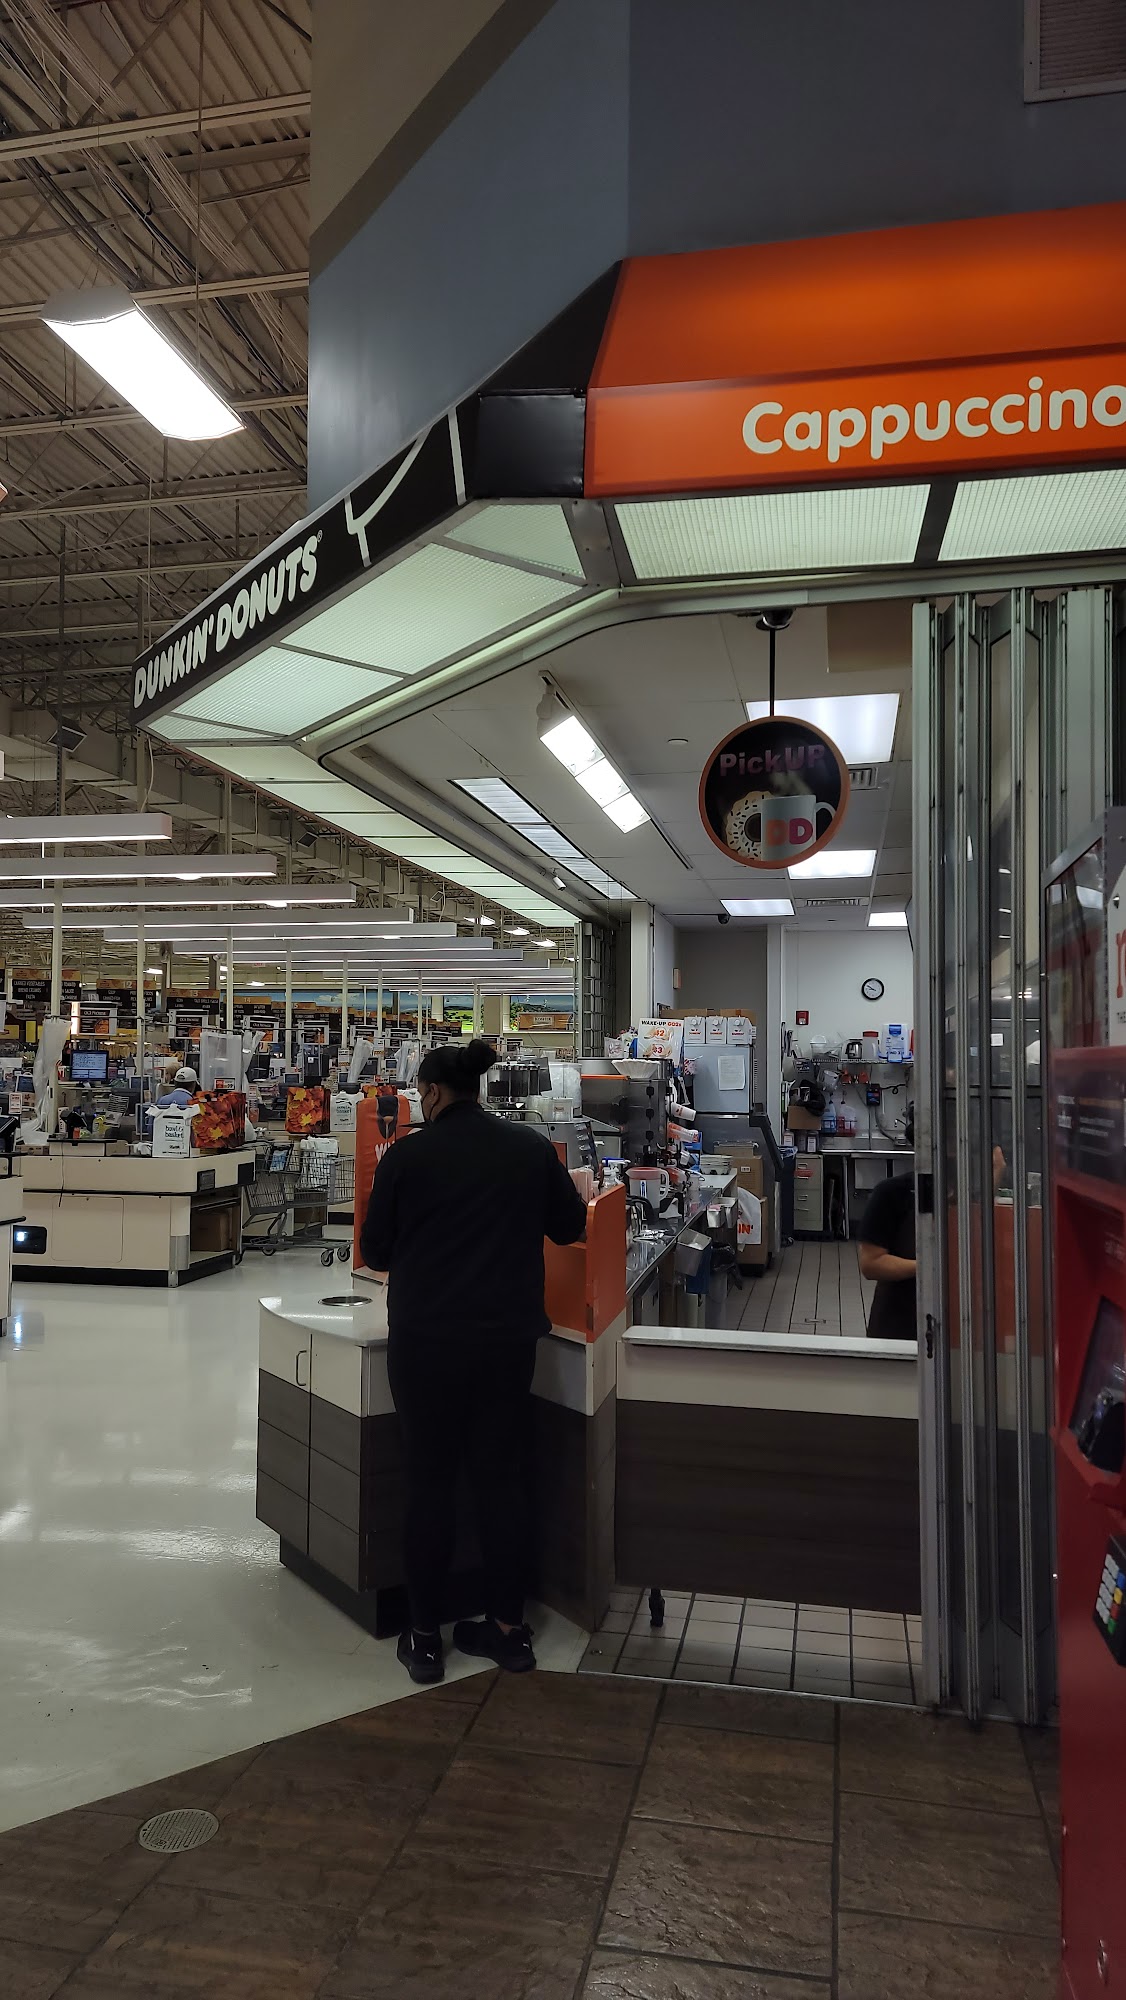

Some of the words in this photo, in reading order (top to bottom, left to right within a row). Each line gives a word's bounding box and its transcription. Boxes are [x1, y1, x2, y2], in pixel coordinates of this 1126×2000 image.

[742, 375, 1126, 463] Cappuccino
[133, 613, 215, 708] DUNKIN'
[765, 817, 814, 847] DD
[123, 980, 133, 988] 12
[641, 1019, 667, 1027] WAKE-UP
